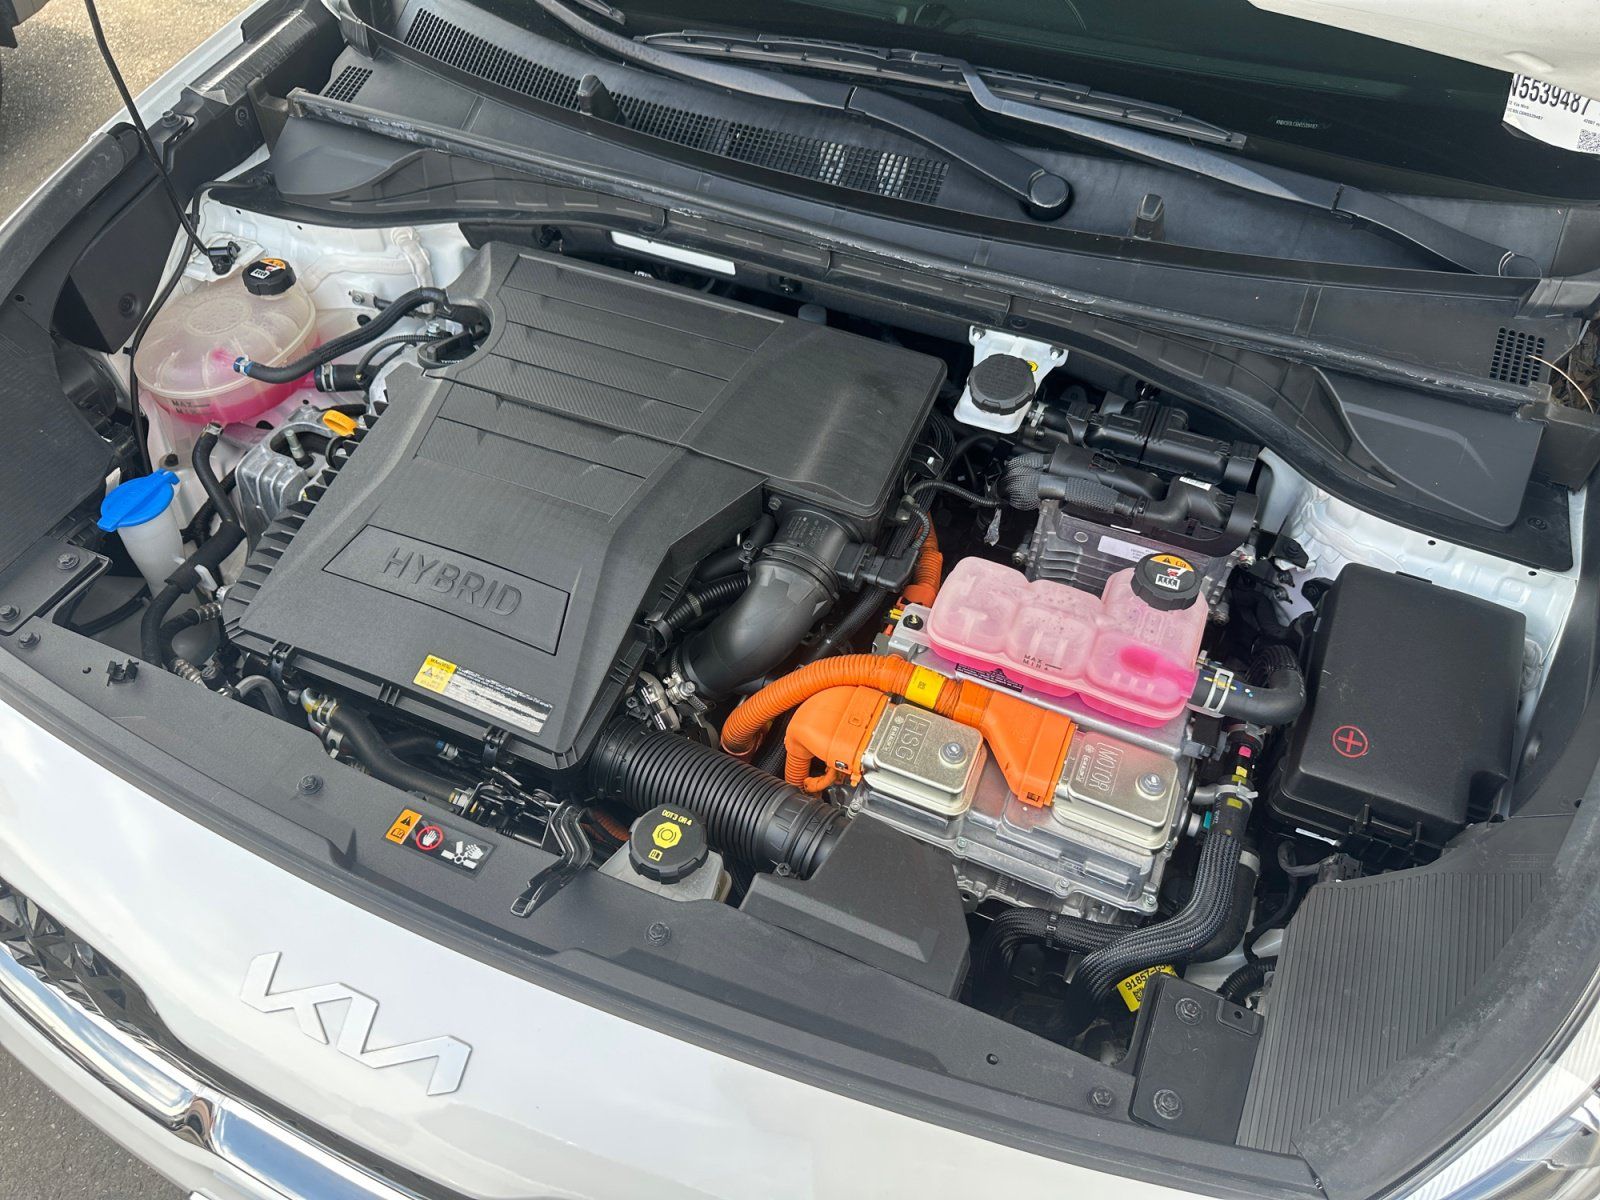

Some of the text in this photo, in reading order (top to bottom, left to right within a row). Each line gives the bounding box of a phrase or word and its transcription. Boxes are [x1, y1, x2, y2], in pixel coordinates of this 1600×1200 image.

[378, 547, 522, 616] HYBRID
[1023, 659, 1041, 668] MIN
[1024, 654, 1043, 664] MAX
[895, 718, 927, 761] HSG
[1089, 747, 1118, 792] MOTOR
[240, 951, 473, 1097] KIA
